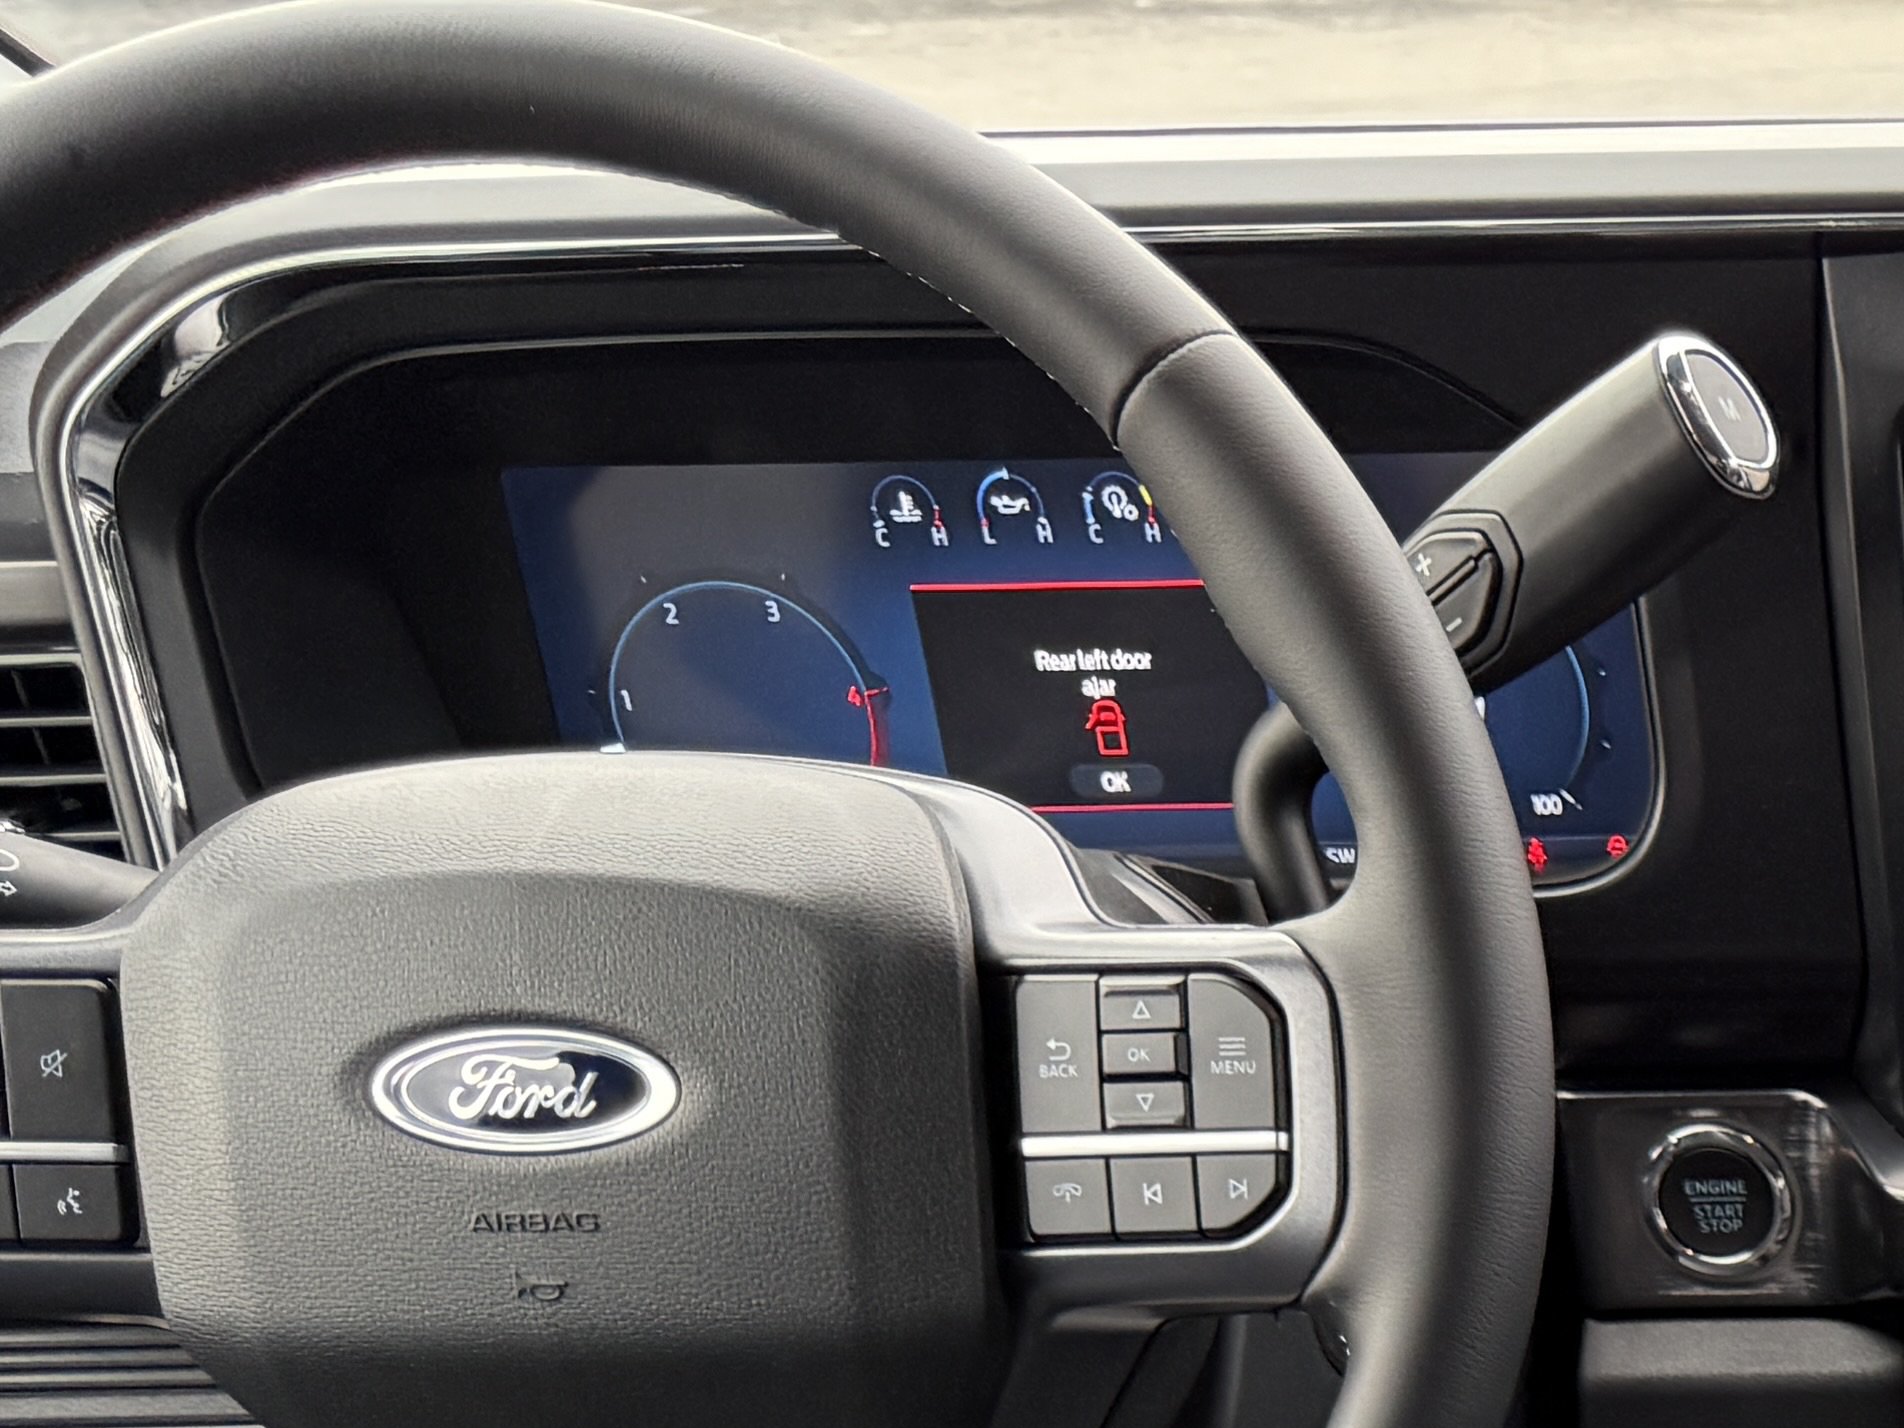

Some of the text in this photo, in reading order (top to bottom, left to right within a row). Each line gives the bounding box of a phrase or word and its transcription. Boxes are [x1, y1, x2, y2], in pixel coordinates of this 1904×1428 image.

[1718, 395, 1742, 422] M
[875, 528, 891, 547] C
[931, 526, 949, 546] H
[982, 527, 997, 545] L
[1036, 523, 1053, 543] H
[1088, 523, 1104, 544] C
[1145, 522, 1162, 543] H
[663, 602, 679, 625] 2
[765, 600, 781, 623] 3
[1034, 648, 1152, 671] Rear left door
[620, 689, 633, 711] 1
[1100, 771, 1131, 793] OK
[1127, 1048, 1151, 1062] OK
[1039, 1064, 1078, 1079] BACK
[1210, 1060, 1256, 1075] MENU
[449, 1053, 599, 1121] Ford
[1684, 1179, 1748, 1195] ENGINE
[471, 1211, 601, 1233] AIRBAG
[1693, 1204, 1745, 1220] START
[1700, 1219, 1743, 1234] STOP
